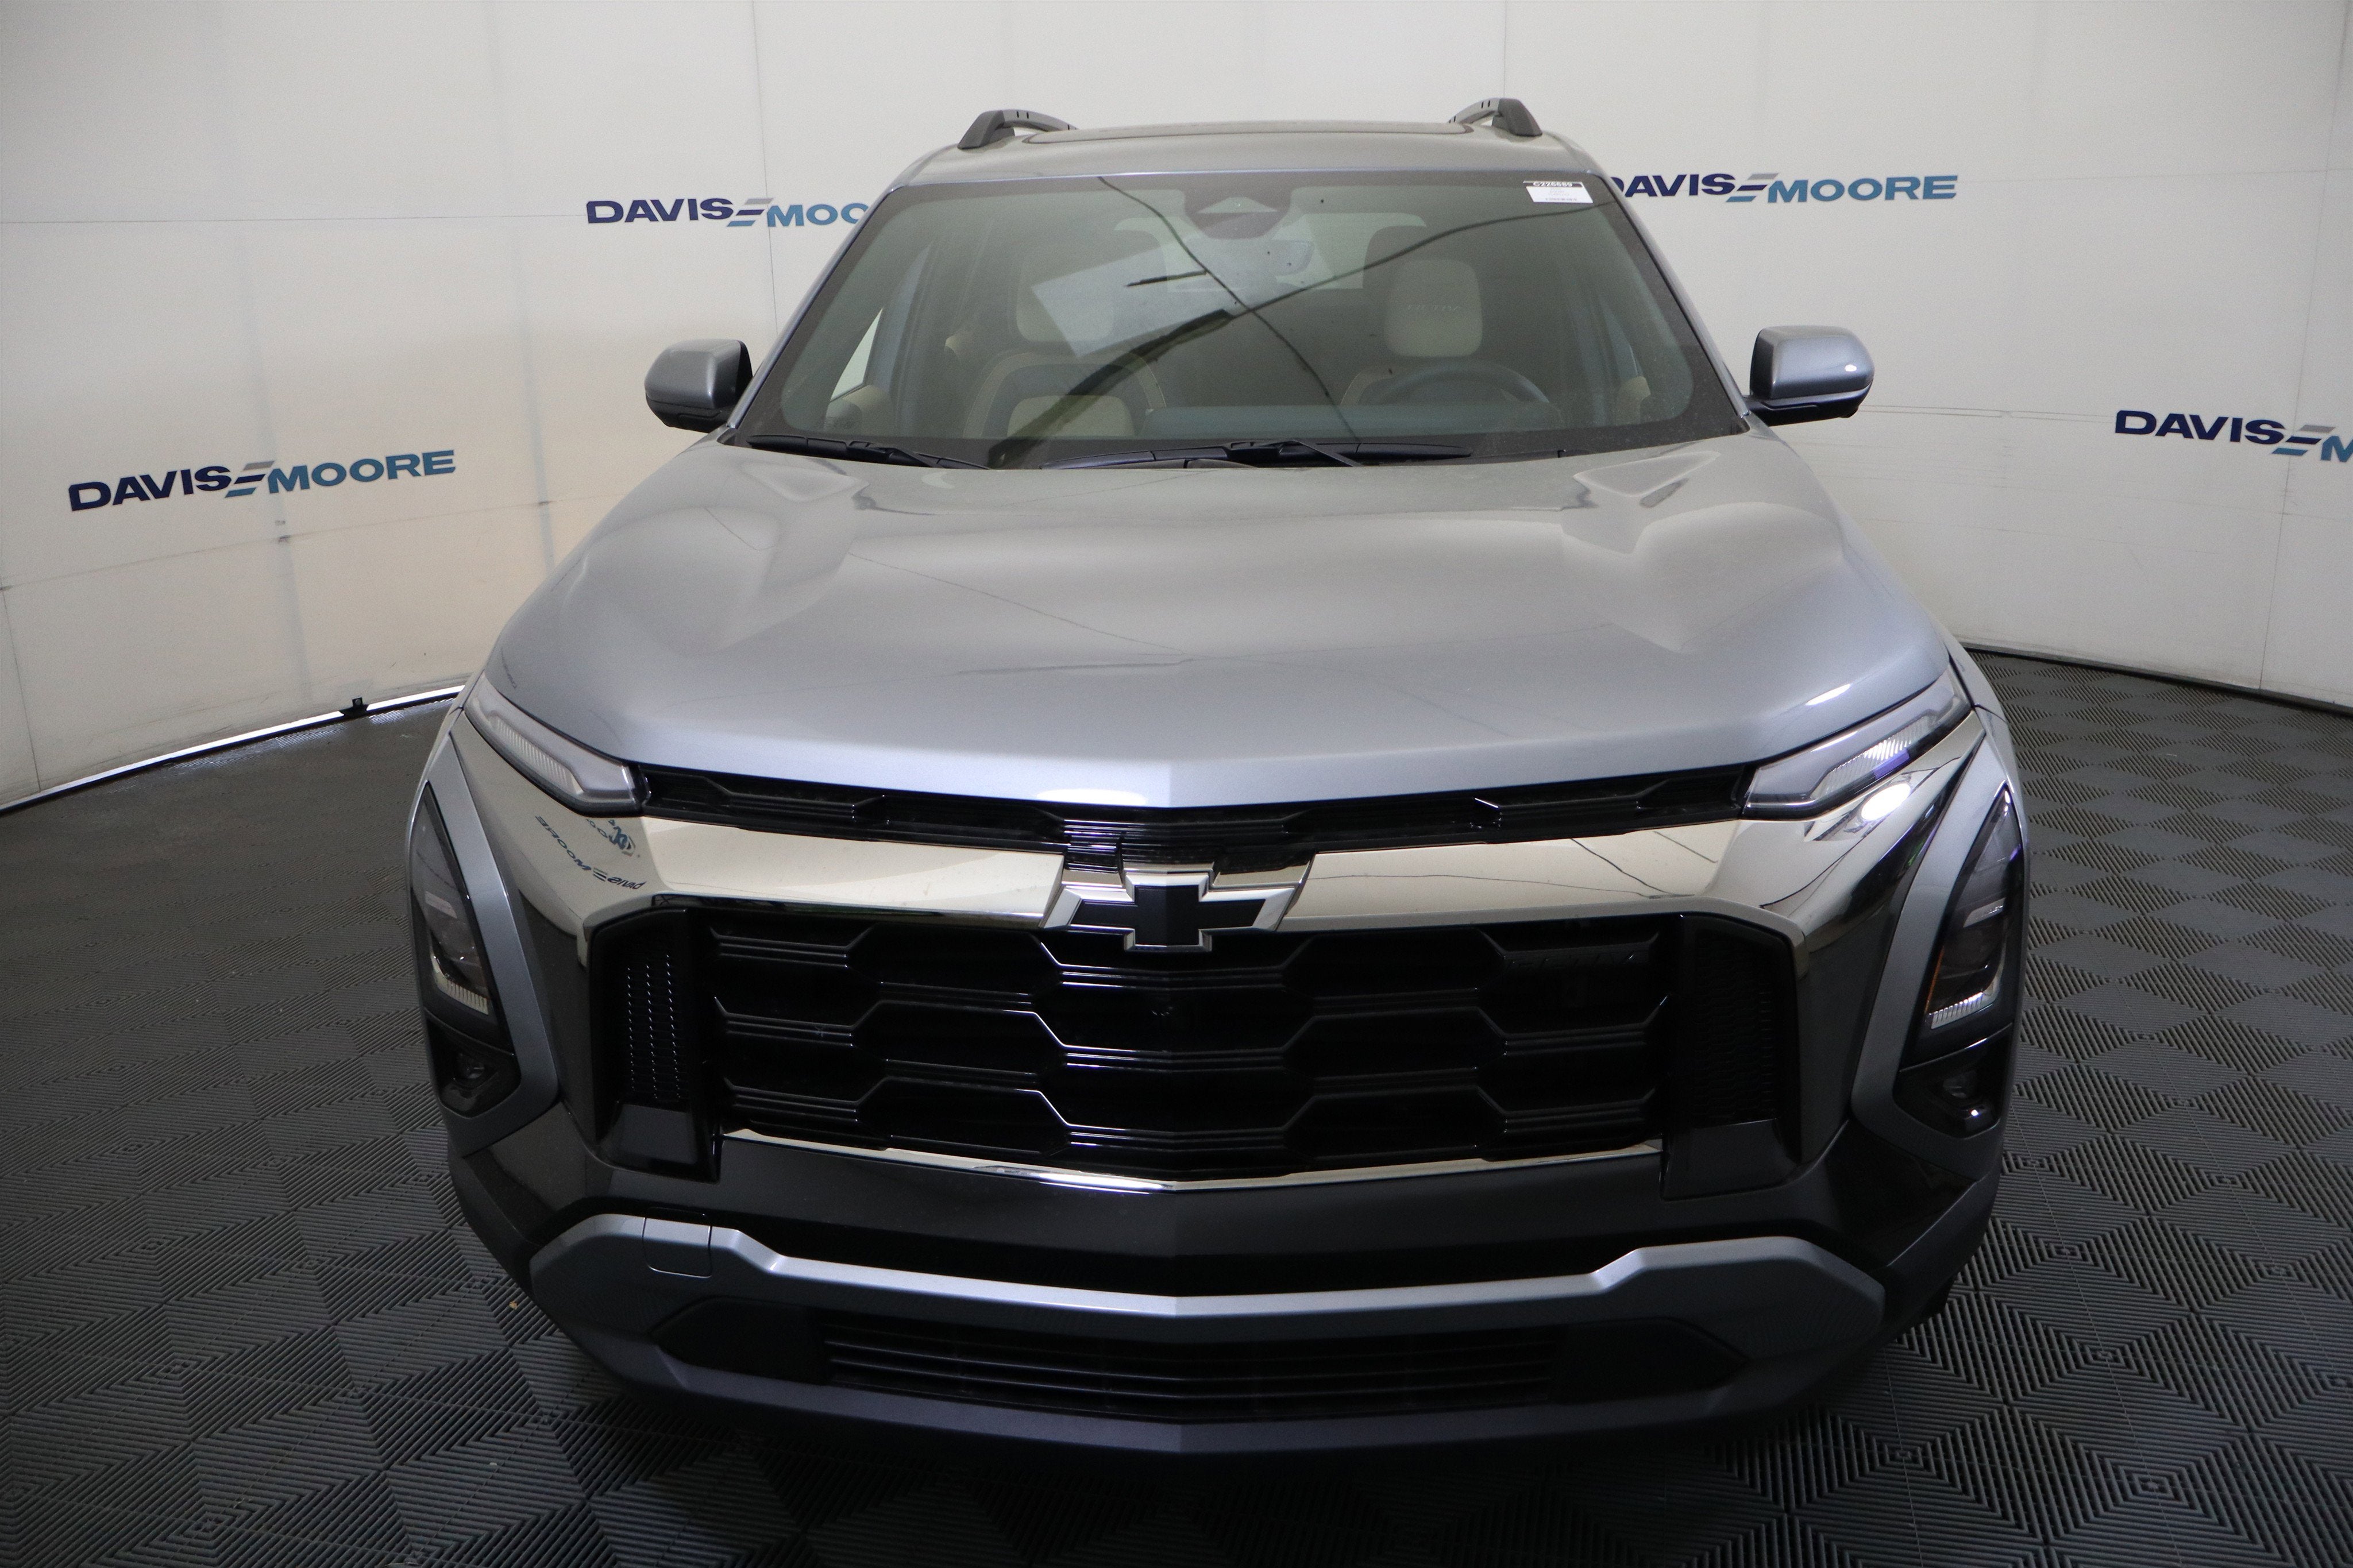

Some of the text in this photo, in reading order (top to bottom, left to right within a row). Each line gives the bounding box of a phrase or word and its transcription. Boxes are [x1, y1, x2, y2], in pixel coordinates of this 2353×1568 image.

[1768, 175, 1957, 202] MOORE
[587, 198, 869, 227] DAVIS MOO
[2115, 410, 2285, 445] DAVIS
[68, 450, 455, 511] DAVIS MOORE
